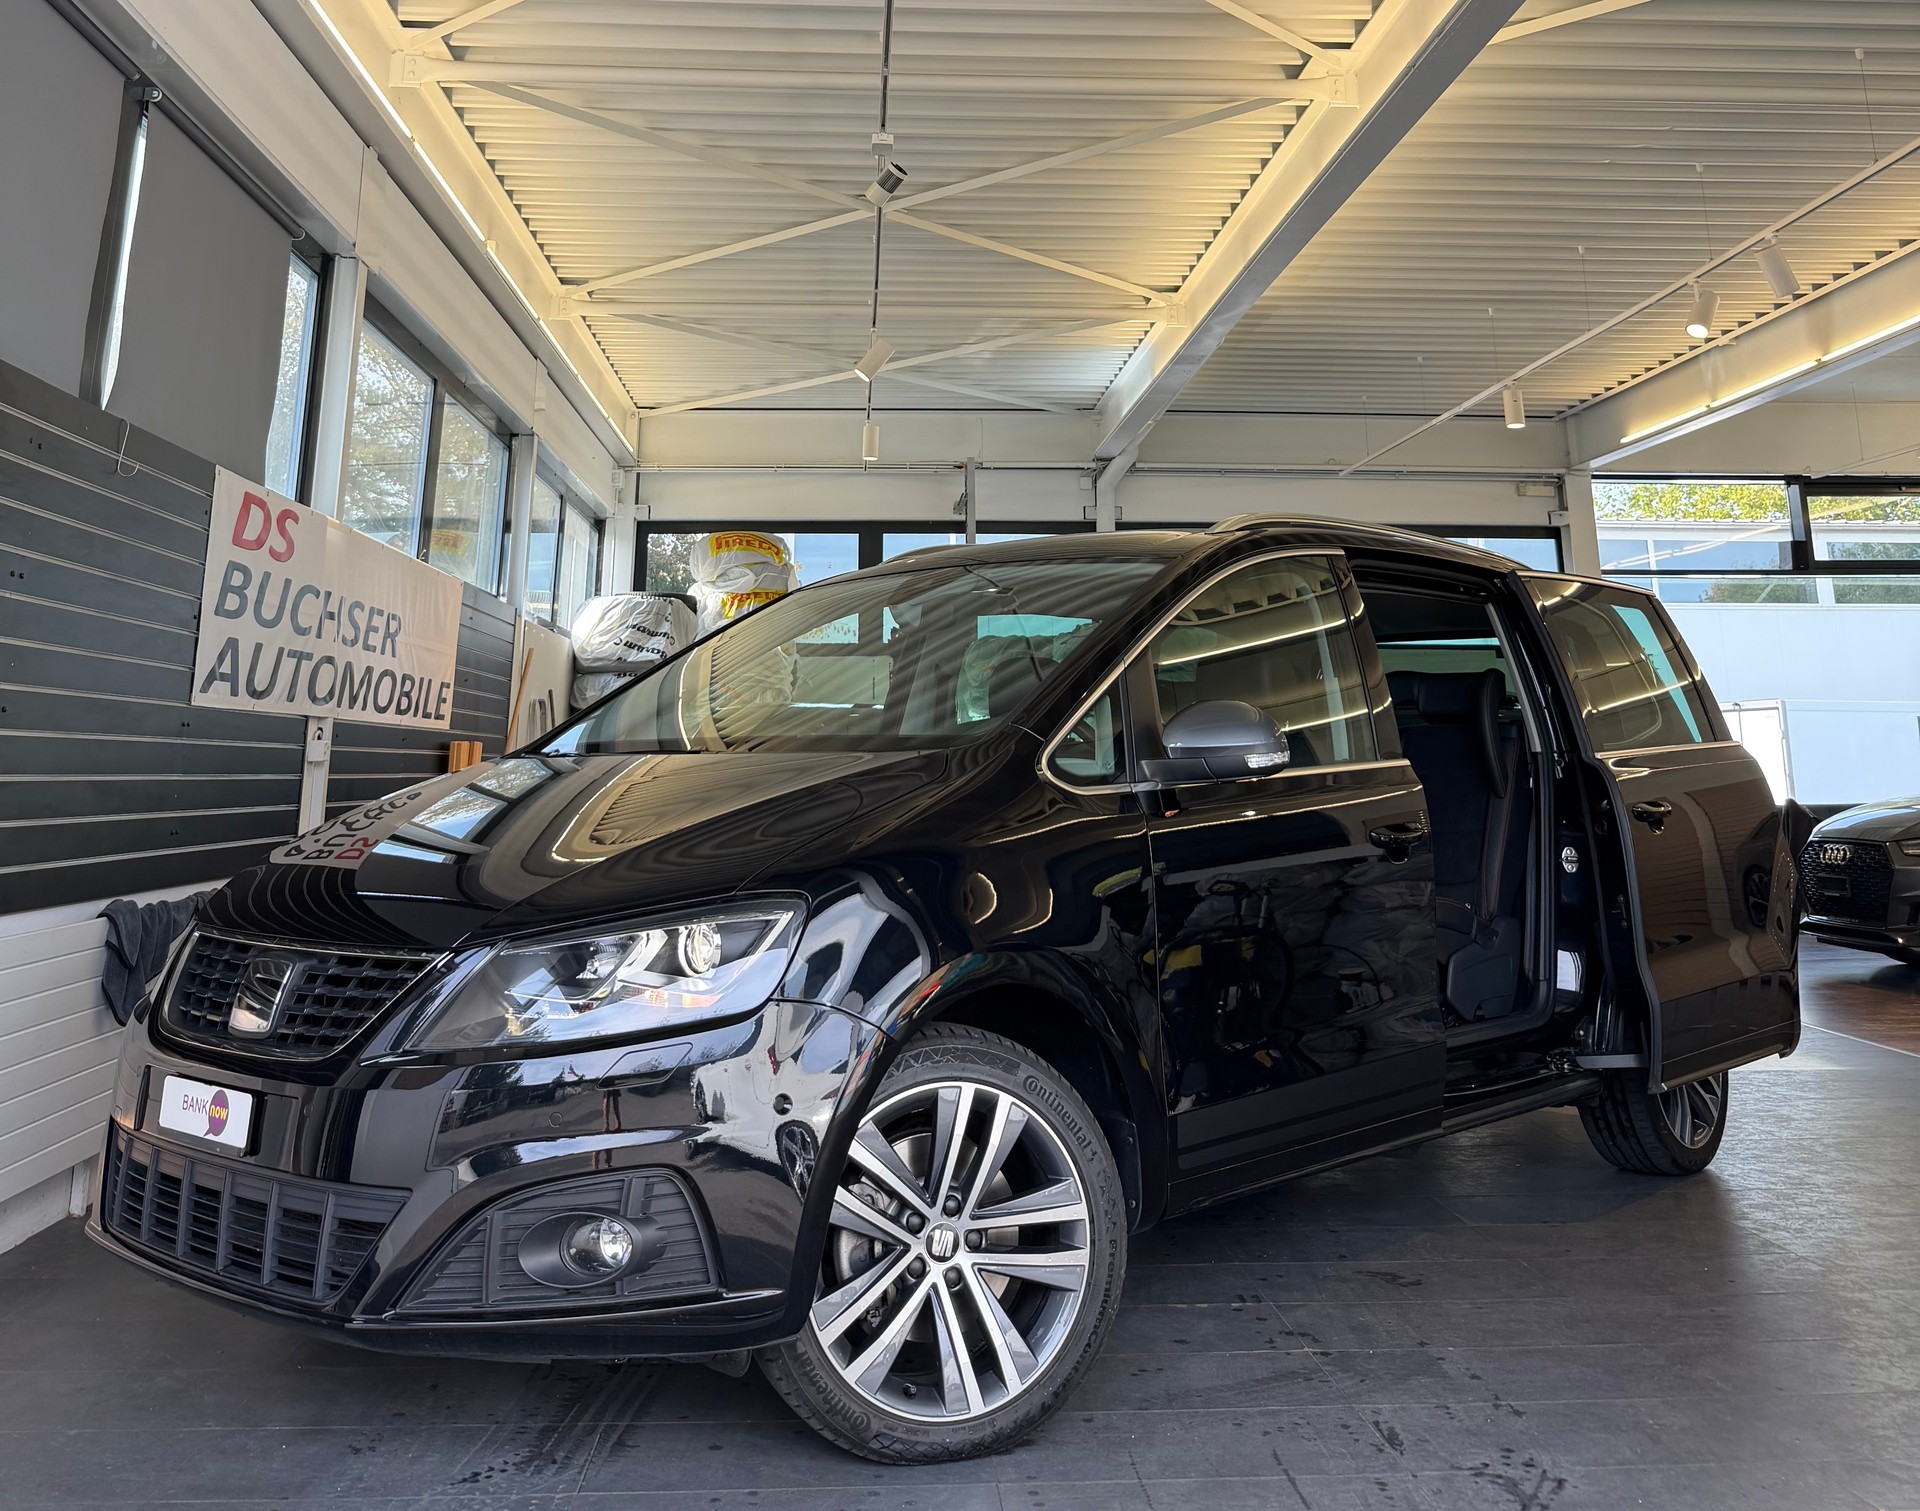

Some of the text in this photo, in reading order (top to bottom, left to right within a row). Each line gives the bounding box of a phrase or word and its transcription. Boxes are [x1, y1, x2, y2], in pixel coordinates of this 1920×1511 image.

[232, 491, 299, 562] DS
[214, 560, 401, 658] BUCHSER
[199, 637, 451, 720] AUTOMOBILE
[182, 1094, 228, 1120] BANK now
[1023, 1075, 1092, 1152] Continental
[794, 1350, 872, 1436] Continental
